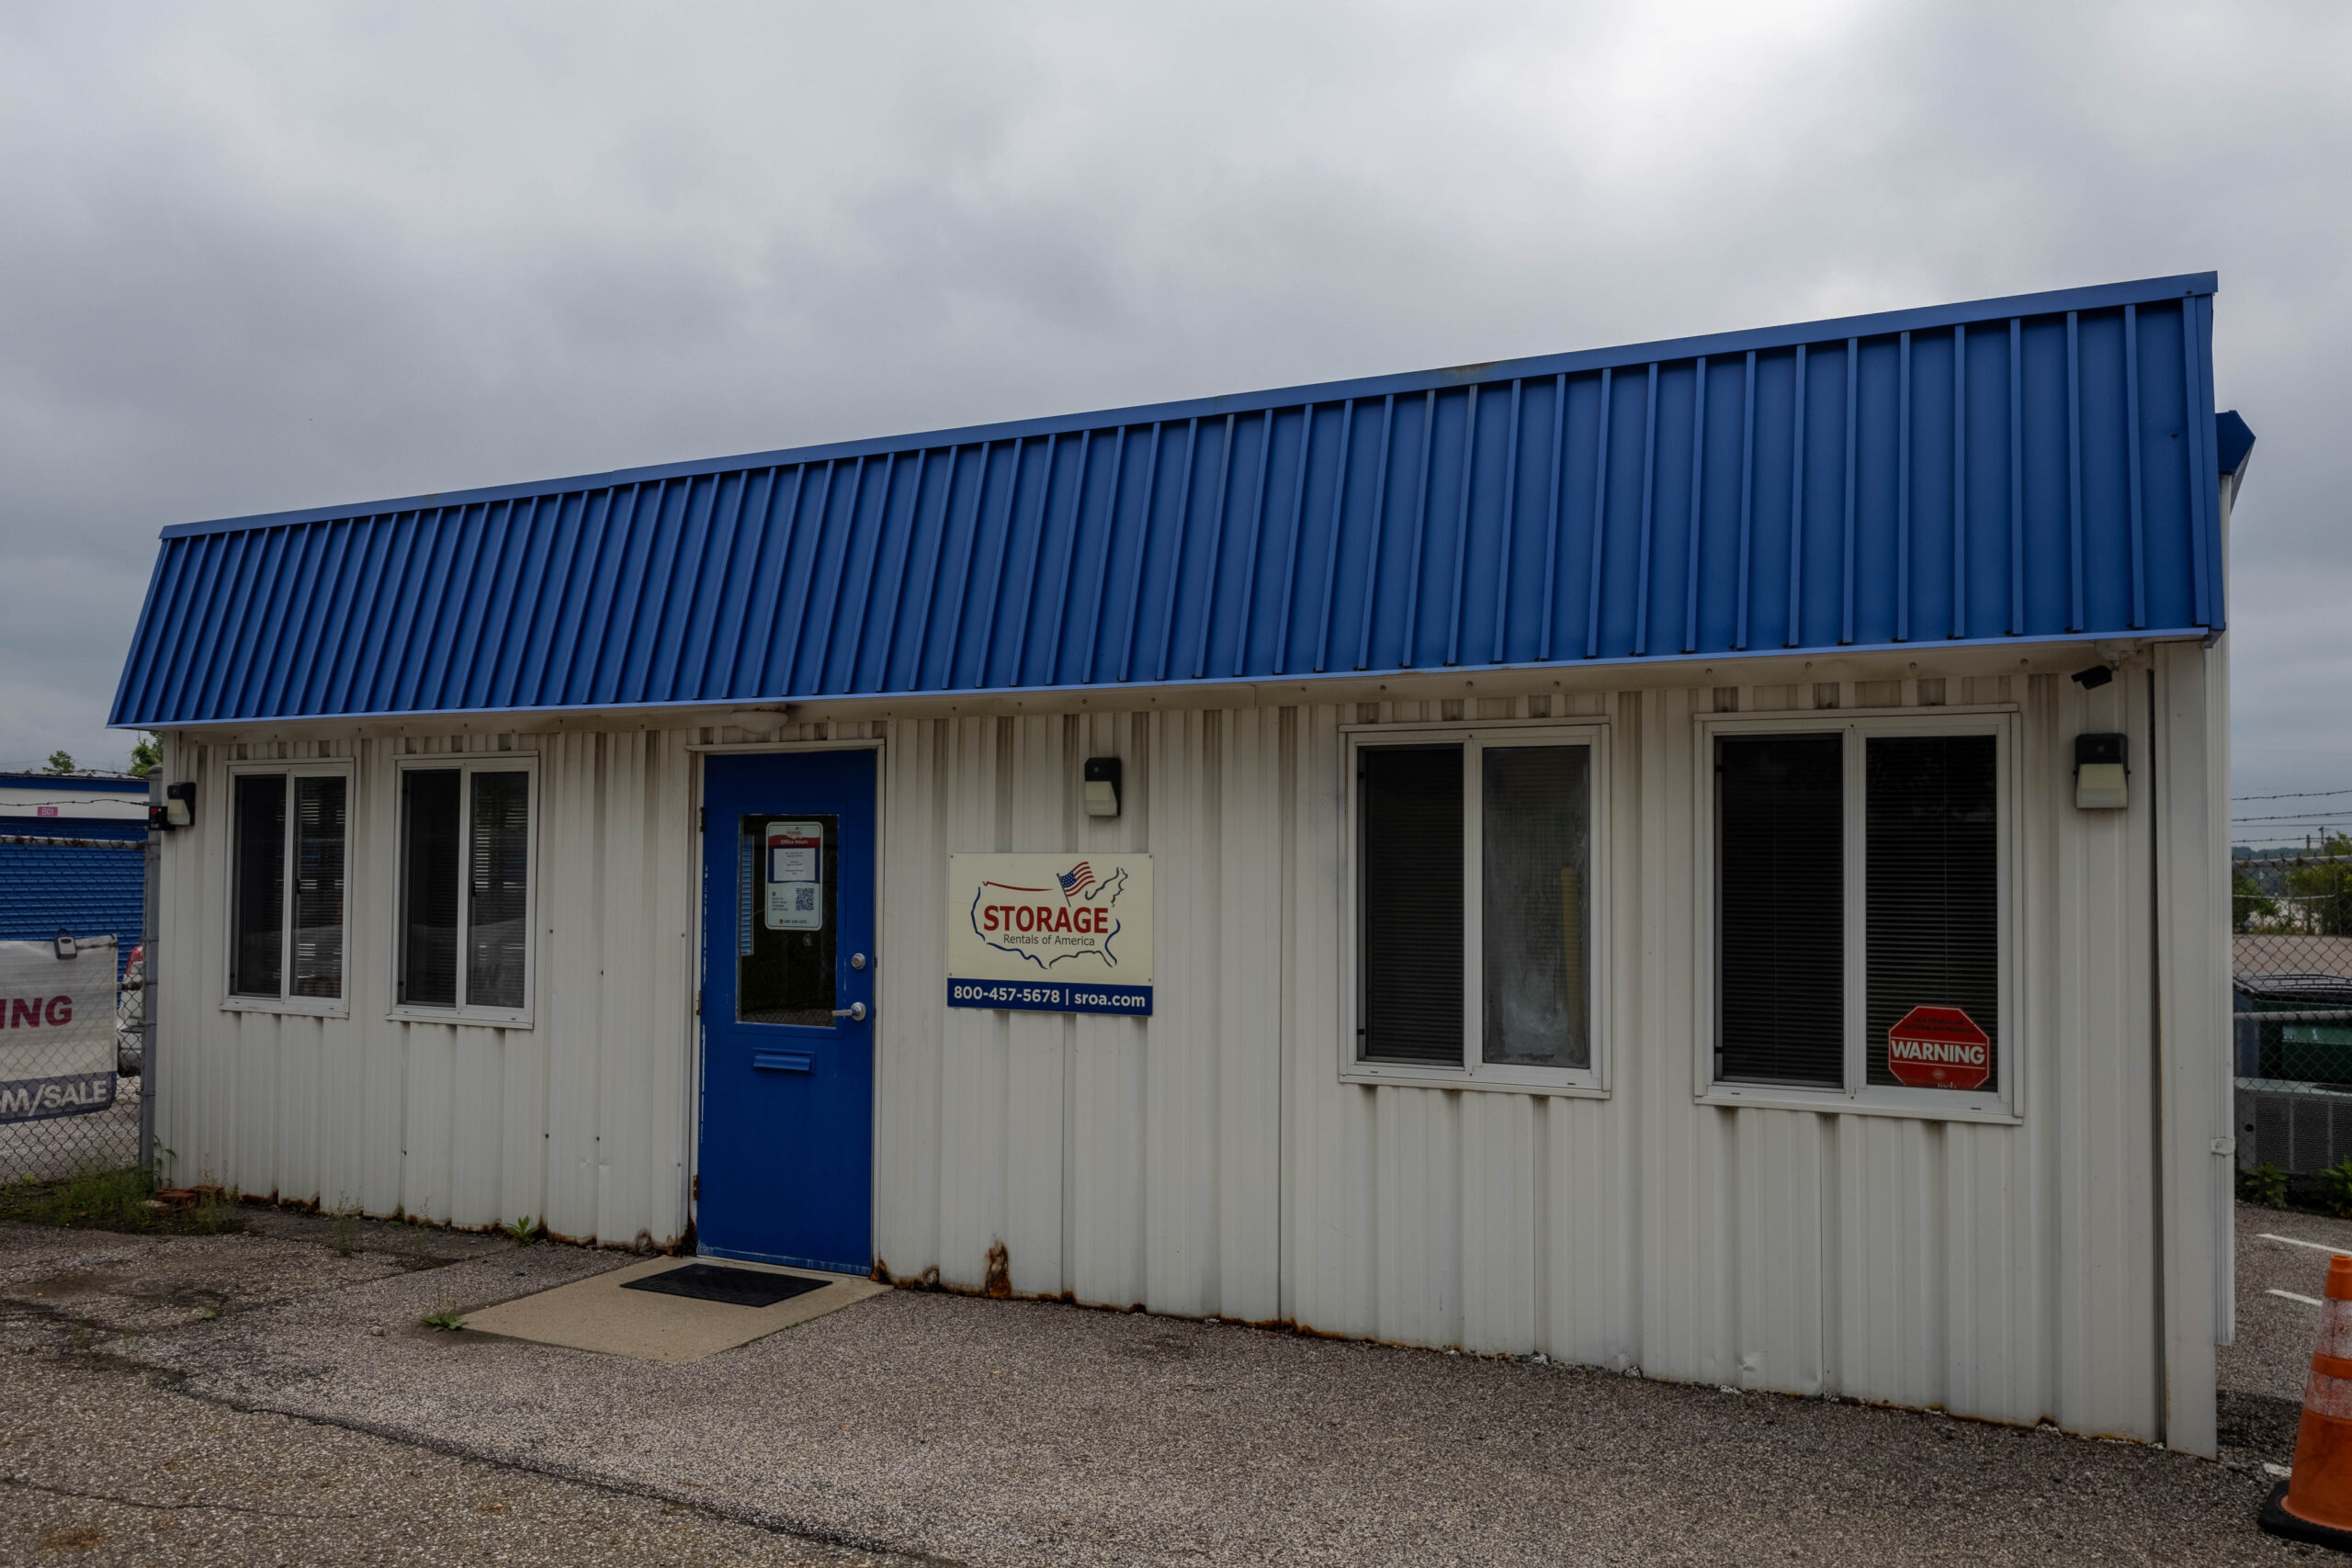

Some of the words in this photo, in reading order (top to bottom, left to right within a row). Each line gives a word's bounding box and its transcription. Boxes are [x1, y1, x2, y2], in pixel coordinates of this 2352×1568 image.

[41, 807, 54, 816] B01
[983, 905, 1109, 934] STORAGE
[1003, 933, 1039, 944] Rentals
[1042, 934, 1052, 945] of
[1055, 935, 1095, 946] America
[954, 986, 1060, 1003] 800-457-5678
[1074, 992, 1146, 1008] sroa.com
[1891, 1040, 1985, 1065] WARNING
[0, 1080, 107, 1117] M/SALE
